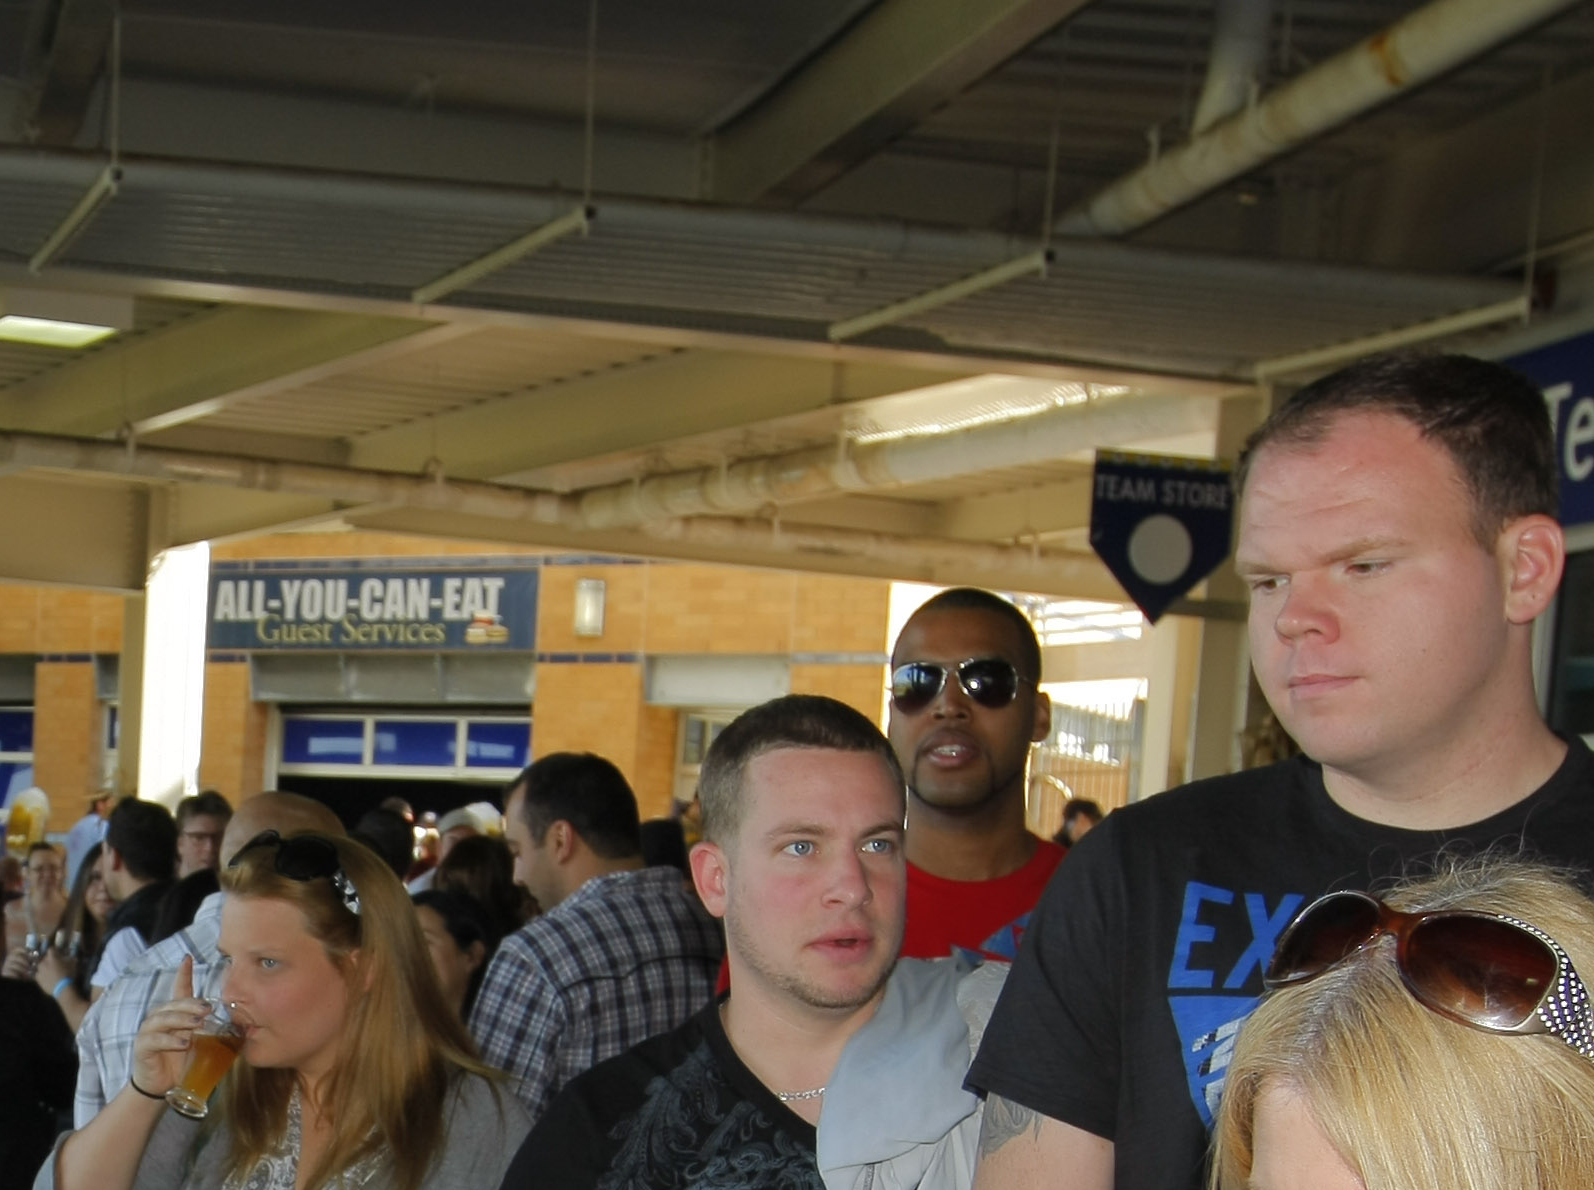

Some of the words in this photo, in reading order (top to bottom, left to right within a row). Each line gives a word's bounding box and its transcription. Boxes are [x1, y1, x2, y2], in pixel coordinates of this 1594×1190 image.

[1096, 474, 1156, 502] TEAM
[1162, 480, 1230, 510] STORE
[213, 577, 505, 621] ALL-YOU-CAN-EAT
[256, 614, 334, 645] Guest
[340, 613, 447, 645] Services
